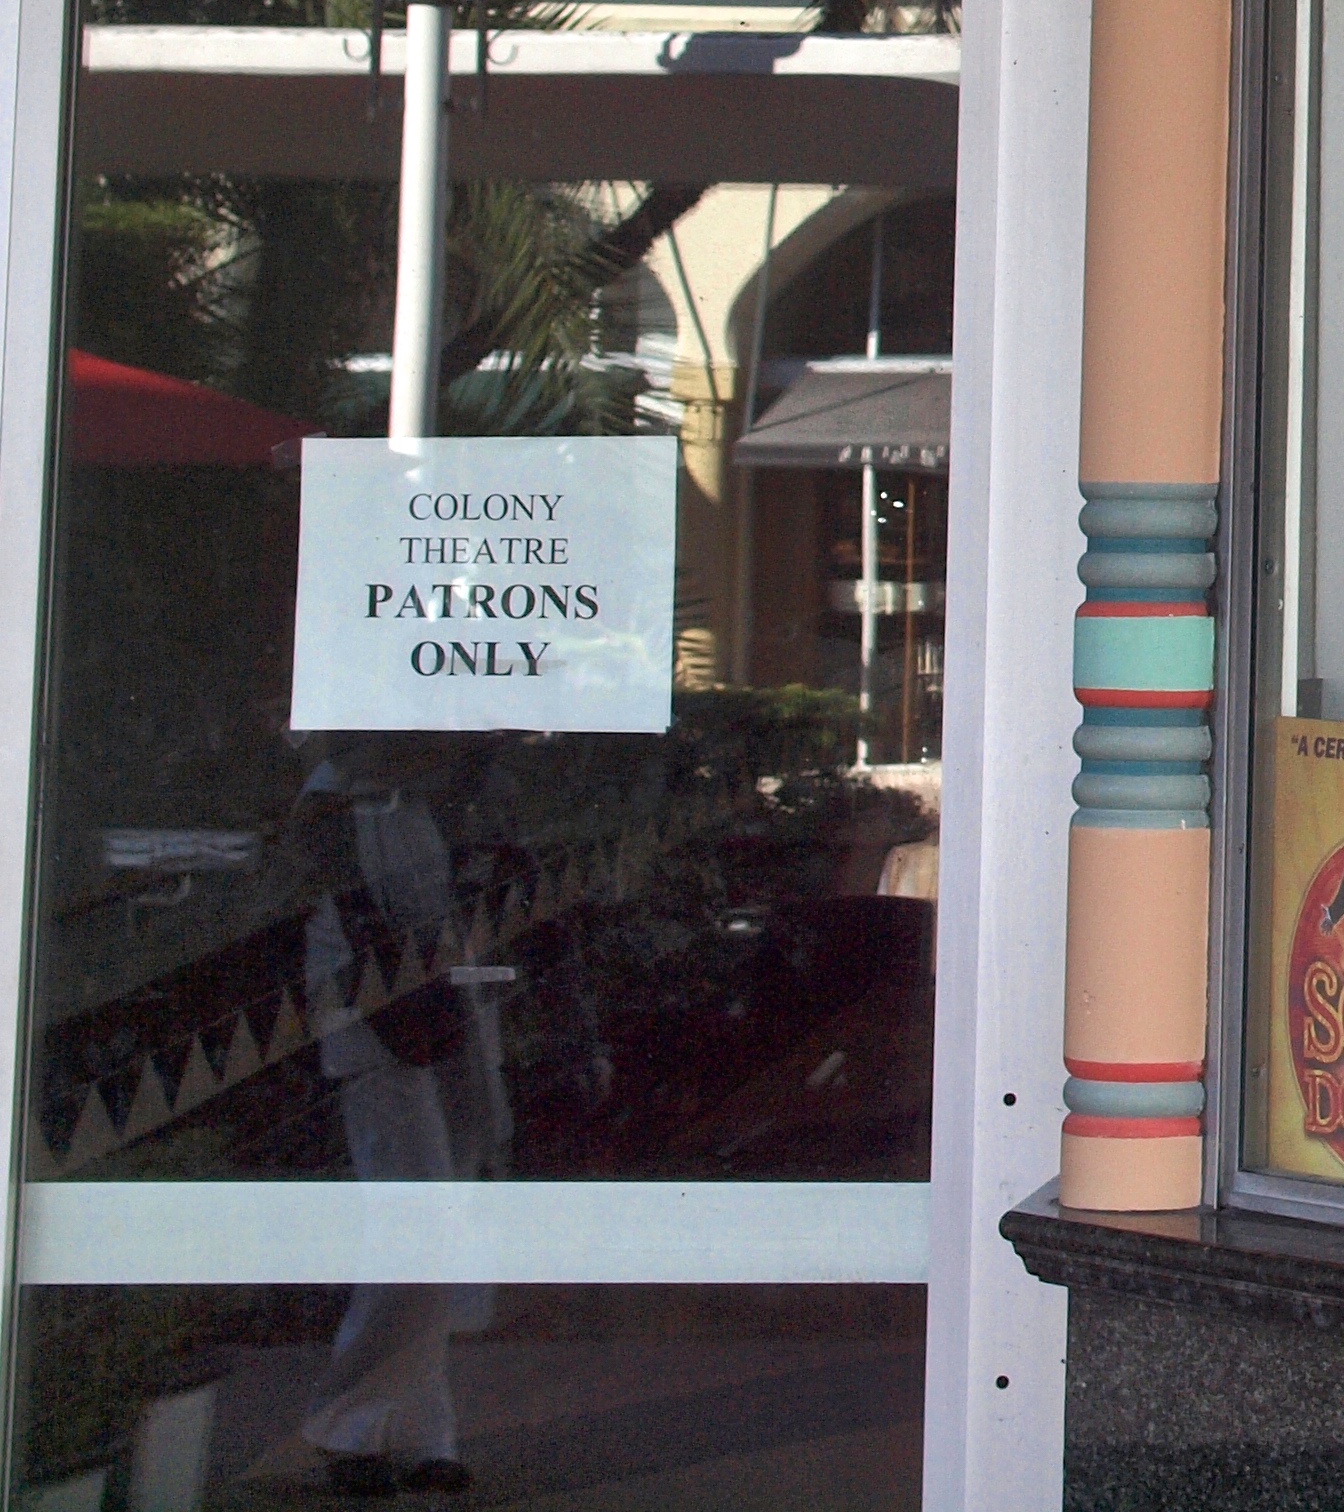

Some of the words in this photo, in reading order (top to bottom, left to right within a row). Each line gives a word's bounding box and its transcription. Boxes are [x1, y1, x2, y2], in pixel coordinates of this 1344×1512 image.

[408, 492, 565, 522] COLONY
[399, 537, 570, 565] THEATRE
[364, 583, 600, 620] PATRONS
[410, 640, 551, 677] ONLY
